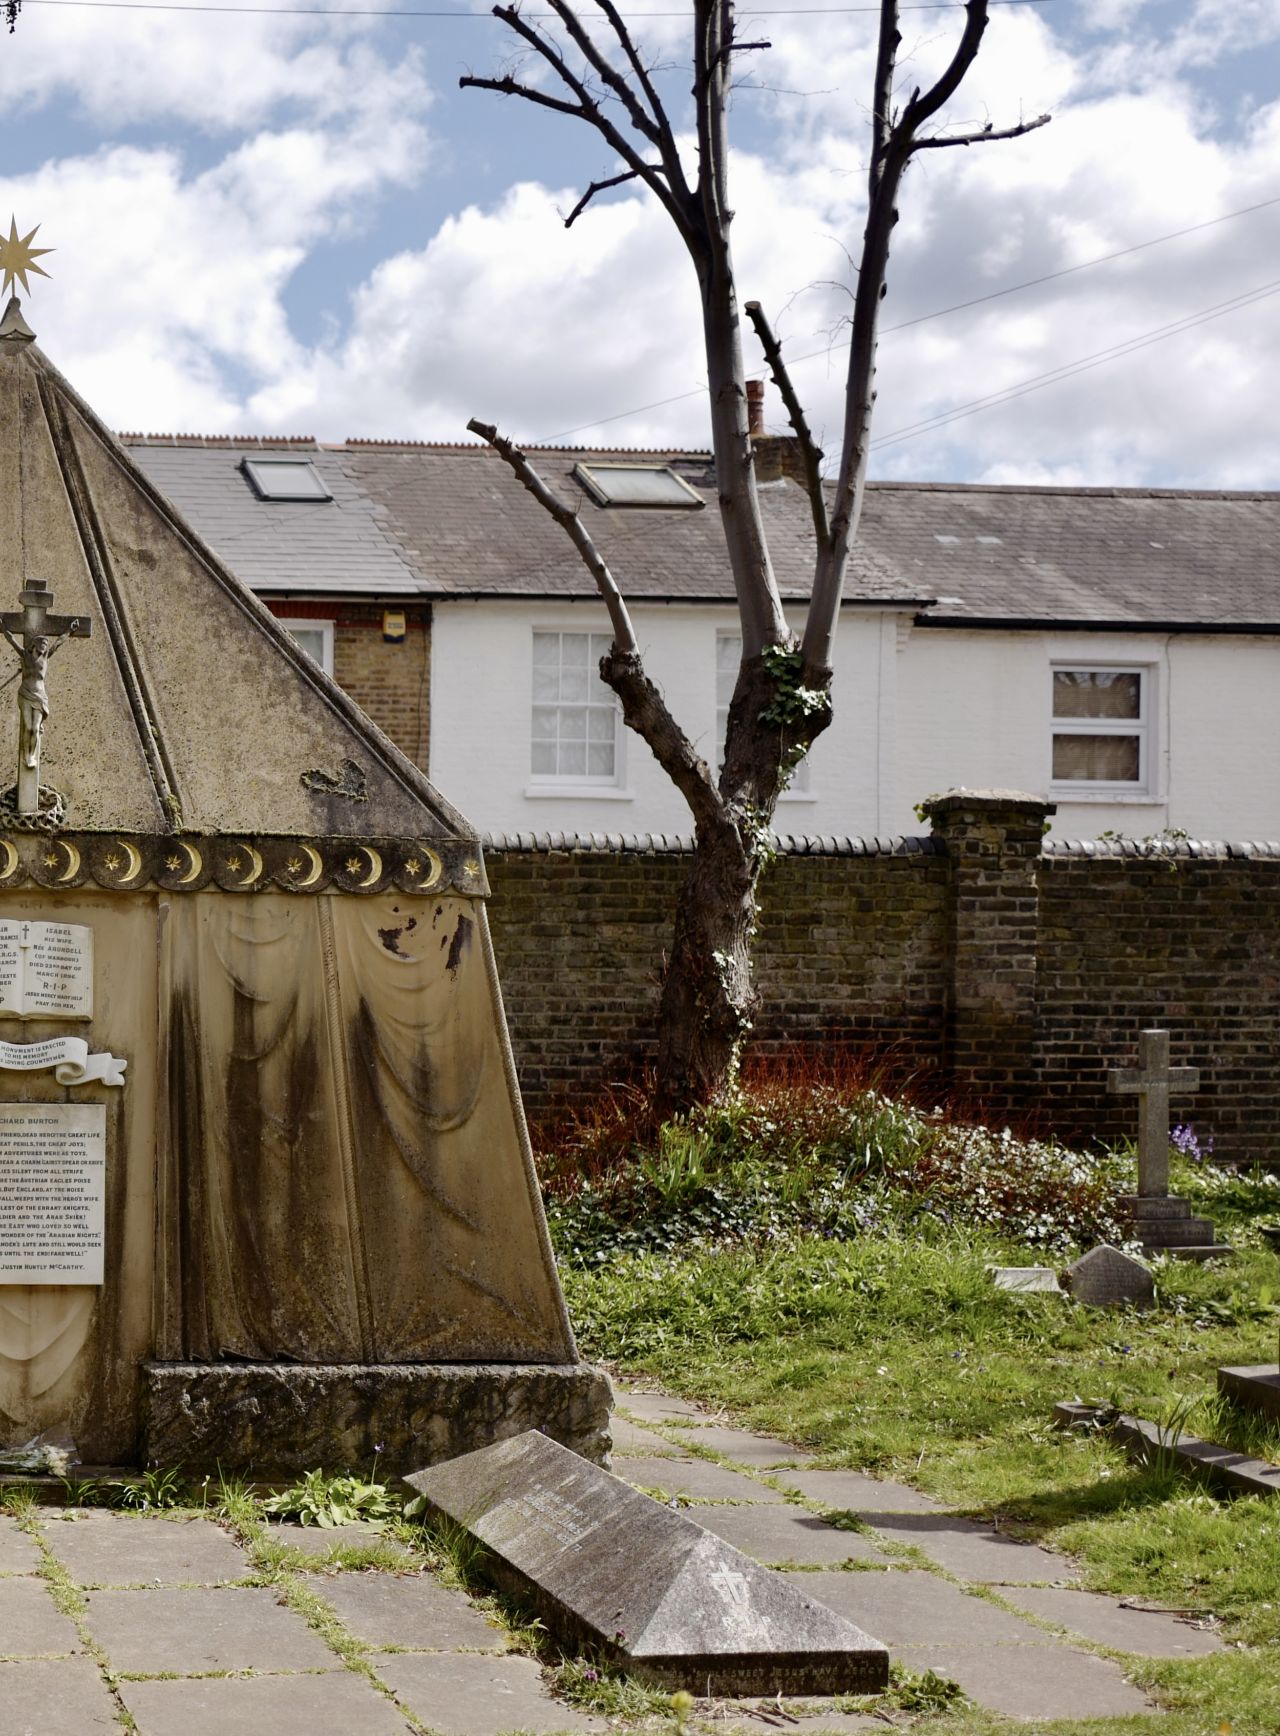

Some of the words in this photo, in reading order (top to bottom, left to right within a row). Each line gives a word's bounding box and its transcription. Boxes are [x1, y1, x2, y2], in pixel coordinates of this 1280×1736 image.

[48, 946, 82, 954] ARUNDELL
[1, 1046, 34, 1054] MONUMENT
[42, 1041, 66, 1051] ERECTED
[26, 1054, 65, 1066] COUNTRYMEN
